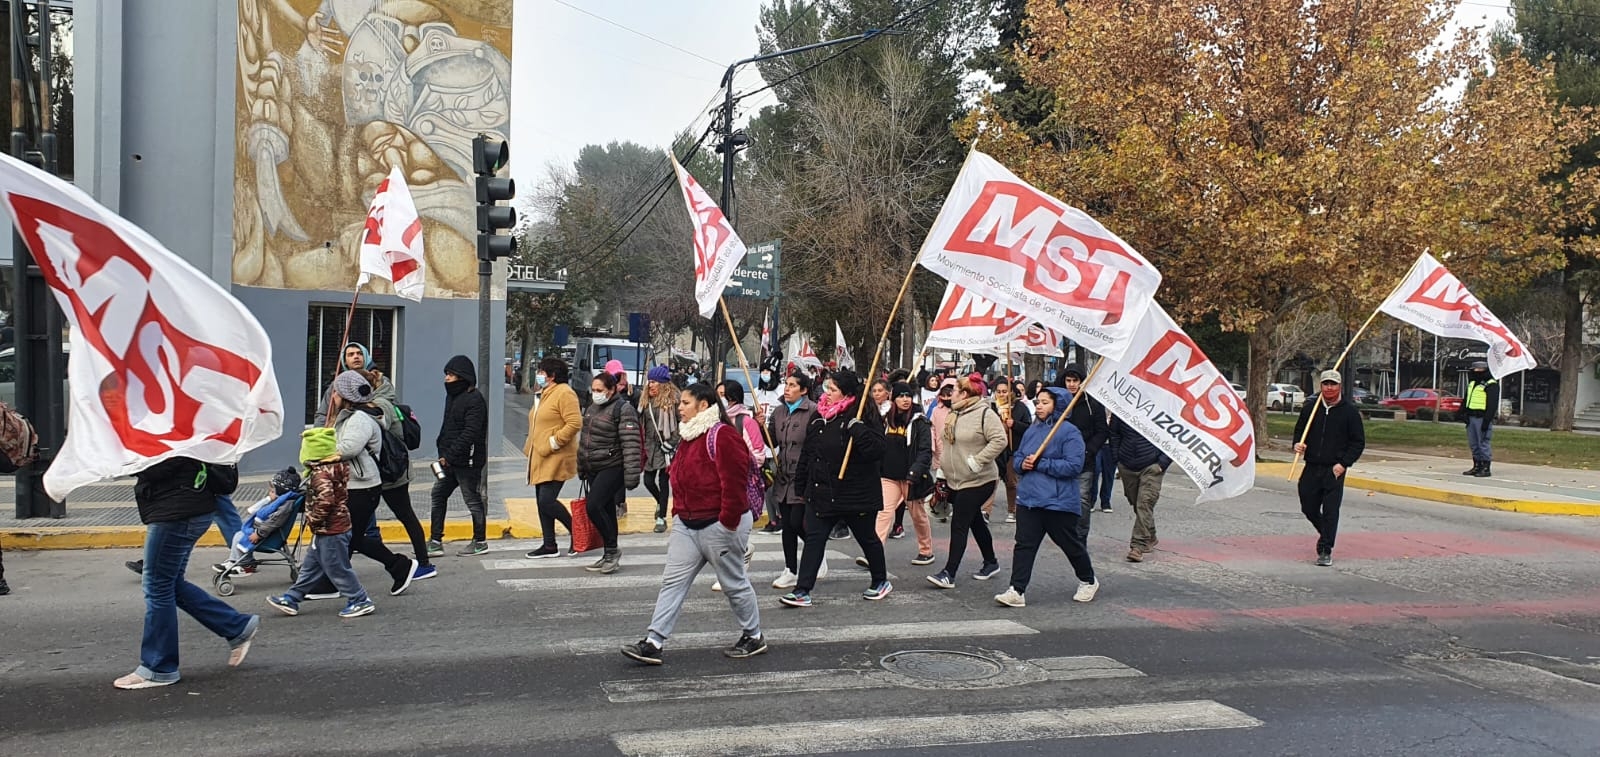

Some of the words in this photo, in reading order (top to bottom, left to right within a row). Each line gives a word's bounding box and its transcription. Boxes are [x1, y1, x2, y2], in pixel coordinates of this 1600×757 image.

[733, 267, 768, 280] derete
[966, 193, 1138, 301] MST
[936, 253, 986, 283] Movimiento
[986, 276, 1029, 302] Socialista
[1029, 296, 1041, 309] de
[1042, 301, 1057, 315] los
[1058, 309, 1115, 344] Trabajadores
[1107, 371, 1156, 417] NUEVA
[1145, 341, 1254, 447] MST
[1171, 447, 1184, 460] los
